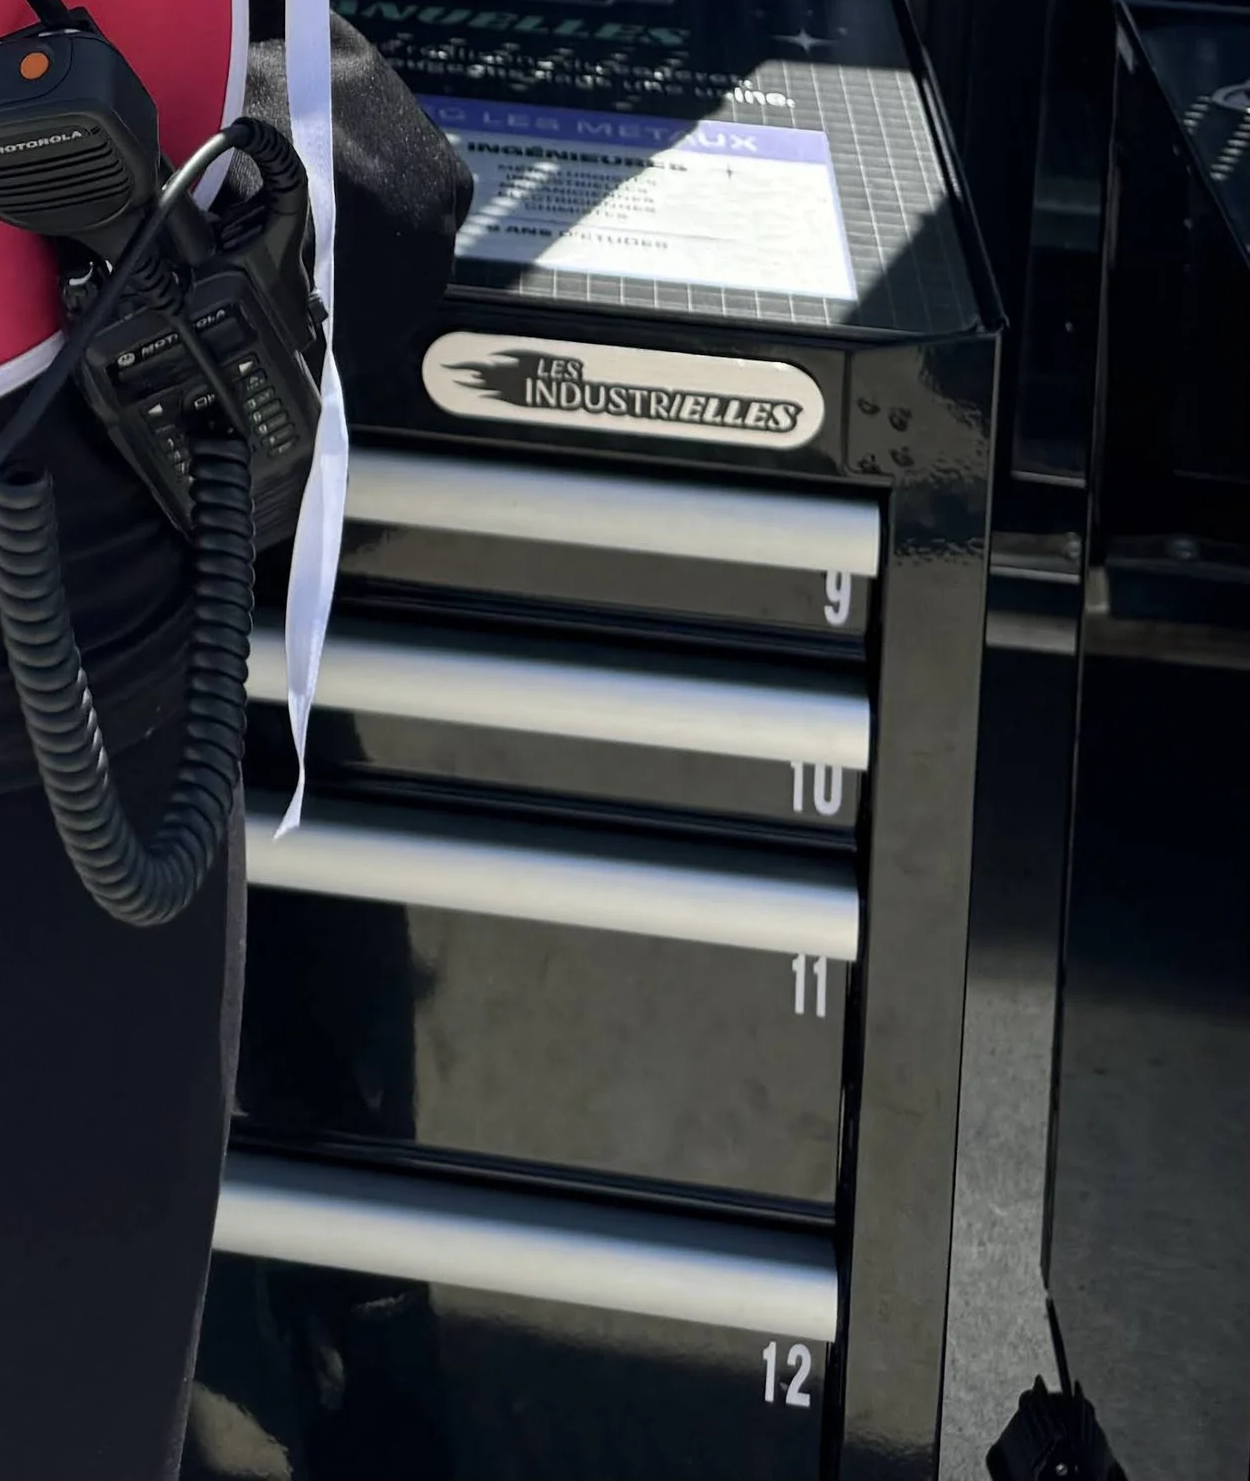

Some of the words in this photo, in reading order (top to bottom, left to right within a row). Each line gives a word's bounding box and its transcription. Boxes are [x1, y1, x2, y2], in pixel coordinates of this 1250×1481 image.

[537, 358, 583, 380] LES
[526, 378, 800, 432] INDUSTRIELLES
[824, 569, 851, 626] 9
[790, 760, 843, 816] 10
[792, 953, 828, 1017] 11
[762, 1341, 812, 1406] 12
